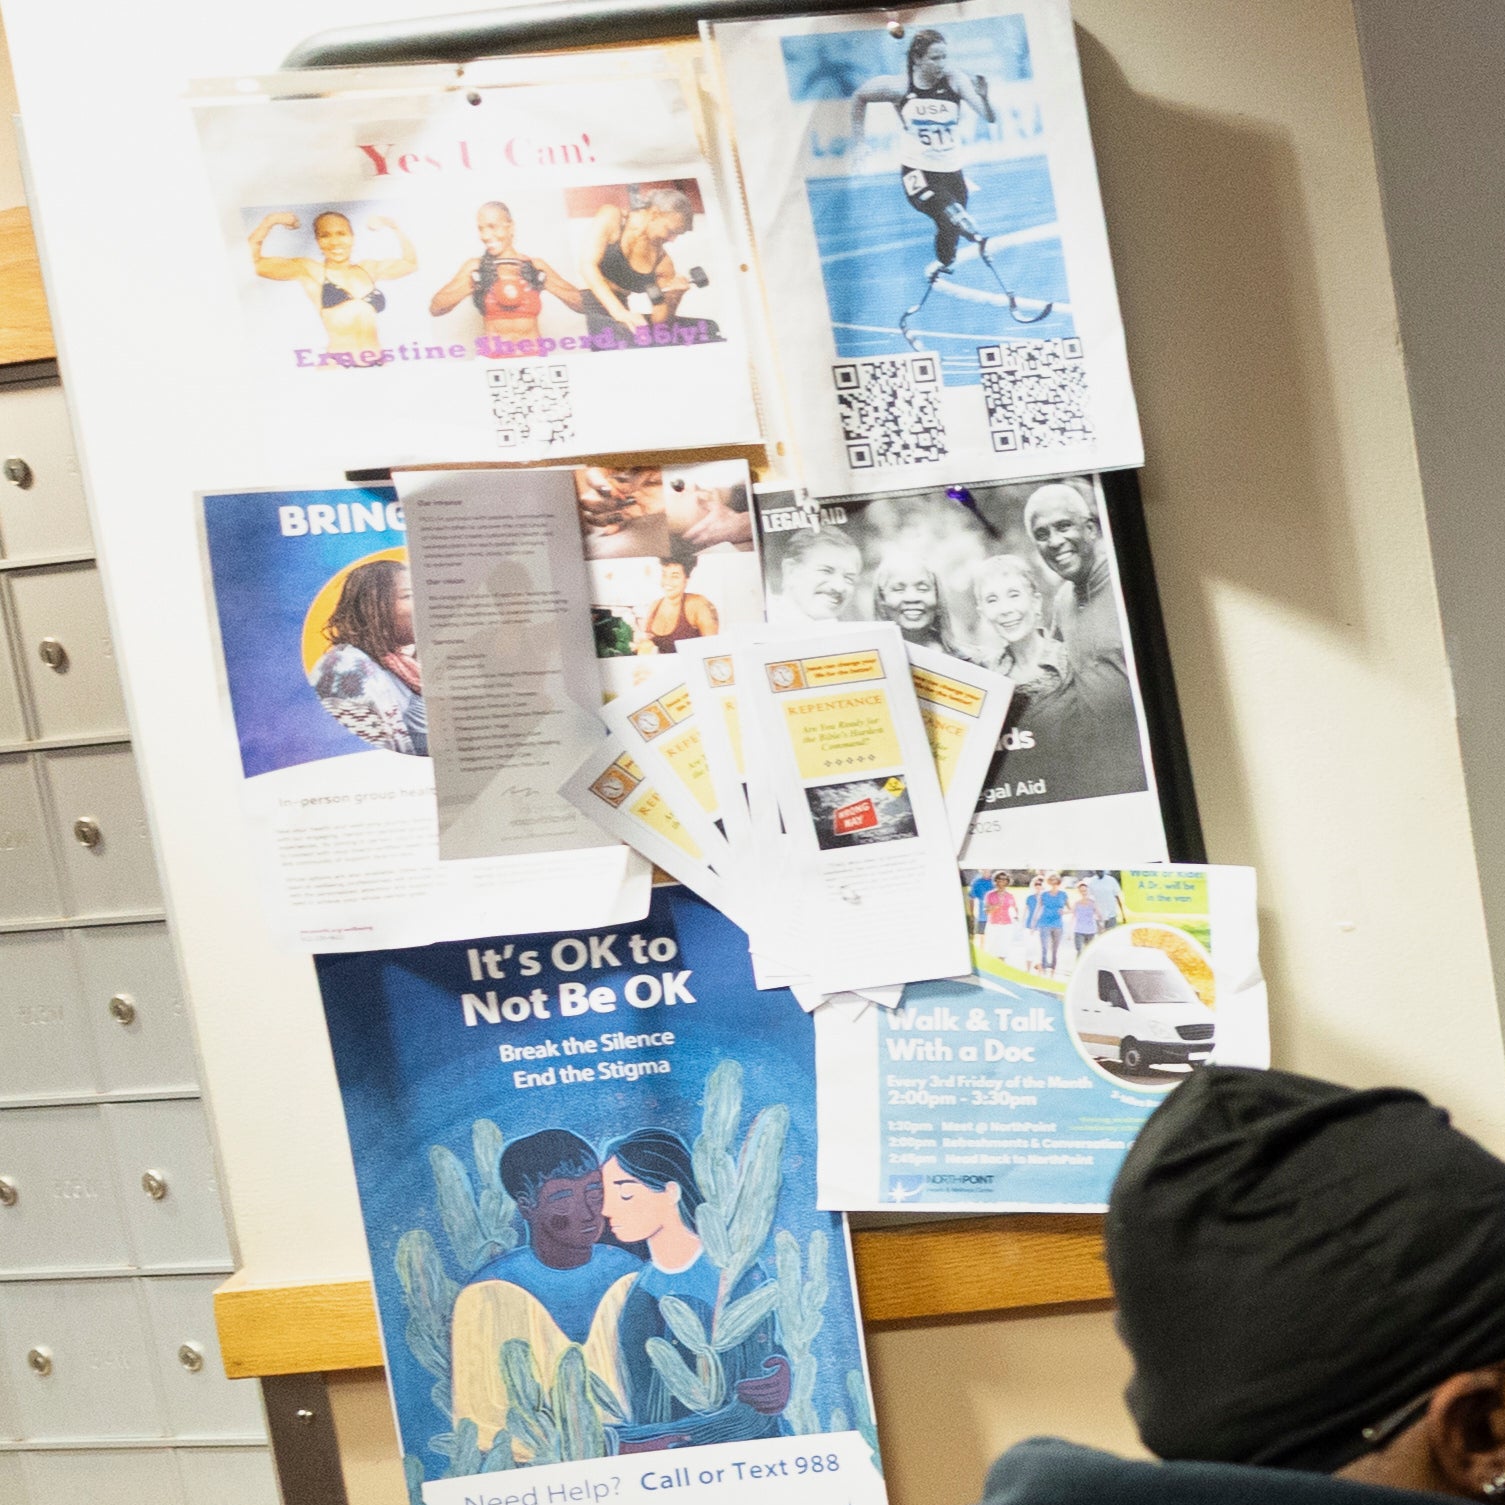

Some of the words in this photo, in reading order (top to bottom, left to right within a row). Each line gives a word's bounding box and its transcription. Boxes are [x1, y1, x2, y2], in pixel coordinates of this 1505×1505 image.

[915, 103, 949, 116] USA
[357, 143, 442, 177] Yes
[504, 133, 596, 167] Can!
[294, 342, 466, 368] Ernestine
[279, 501, 407, 537] BRING
[761, 510, 813, 533] LEGAL
[819, 507, 848, 526] AID
[787, 695, 883, 715] REPENTANCE
[997, 727, 1036, 750] ds
[1016, 779, 1047, 797] Aid
[467, 943, 542, 981] It's
[551, 934, 622, 972] OK
[629, 933, 678, 964] to
[461, 988, 551, 1027] Not
[558, 982, 617, 1017] Be
[624, 969, 698, 1008] OK
[886, 1006, 961, 1031] Walk
[965, 1007, 992, 1031] &
[994, 1007, 1056, 1032] Talk
[499, 1039, 561, 1063] Break
[562, 1037, 598, 1055] the
[600, 1031, 675, 1052] Silence
[885, 1037, 953, 1062] With
[958, 1045, 978, 1062] a
[984, 1038, 1037, 1063] Doc
[513, 1067, 556, 1089] End
[559, 1065, 595, 1084] the
[597, 1060, 671, 1082] Stigma
[886, 1074, 928, 1090] Every
[929, 1074, 956, 1088] 3rd
[957, 1075, 1004, 1091] Friday
[1005, 1075, 1021, 1089] of
[1022, 1075, 1046, 1089] the
[1047, 1076, 1093, 1089] Month
[887, 1089, 957, 1109] 2:00pm
[970, 1090, 1038, 1109] 3:30pm
[926, 1174, 995, 1184] NORTHPOINT
[547, 1476, 622, 1505] Help?
[640, 1467, 690, 1491] Call
[699, 1467, 725, 1485] or
[732, 1459, 789, 1482] Text
[795, 1453, 840, 1475] 988
